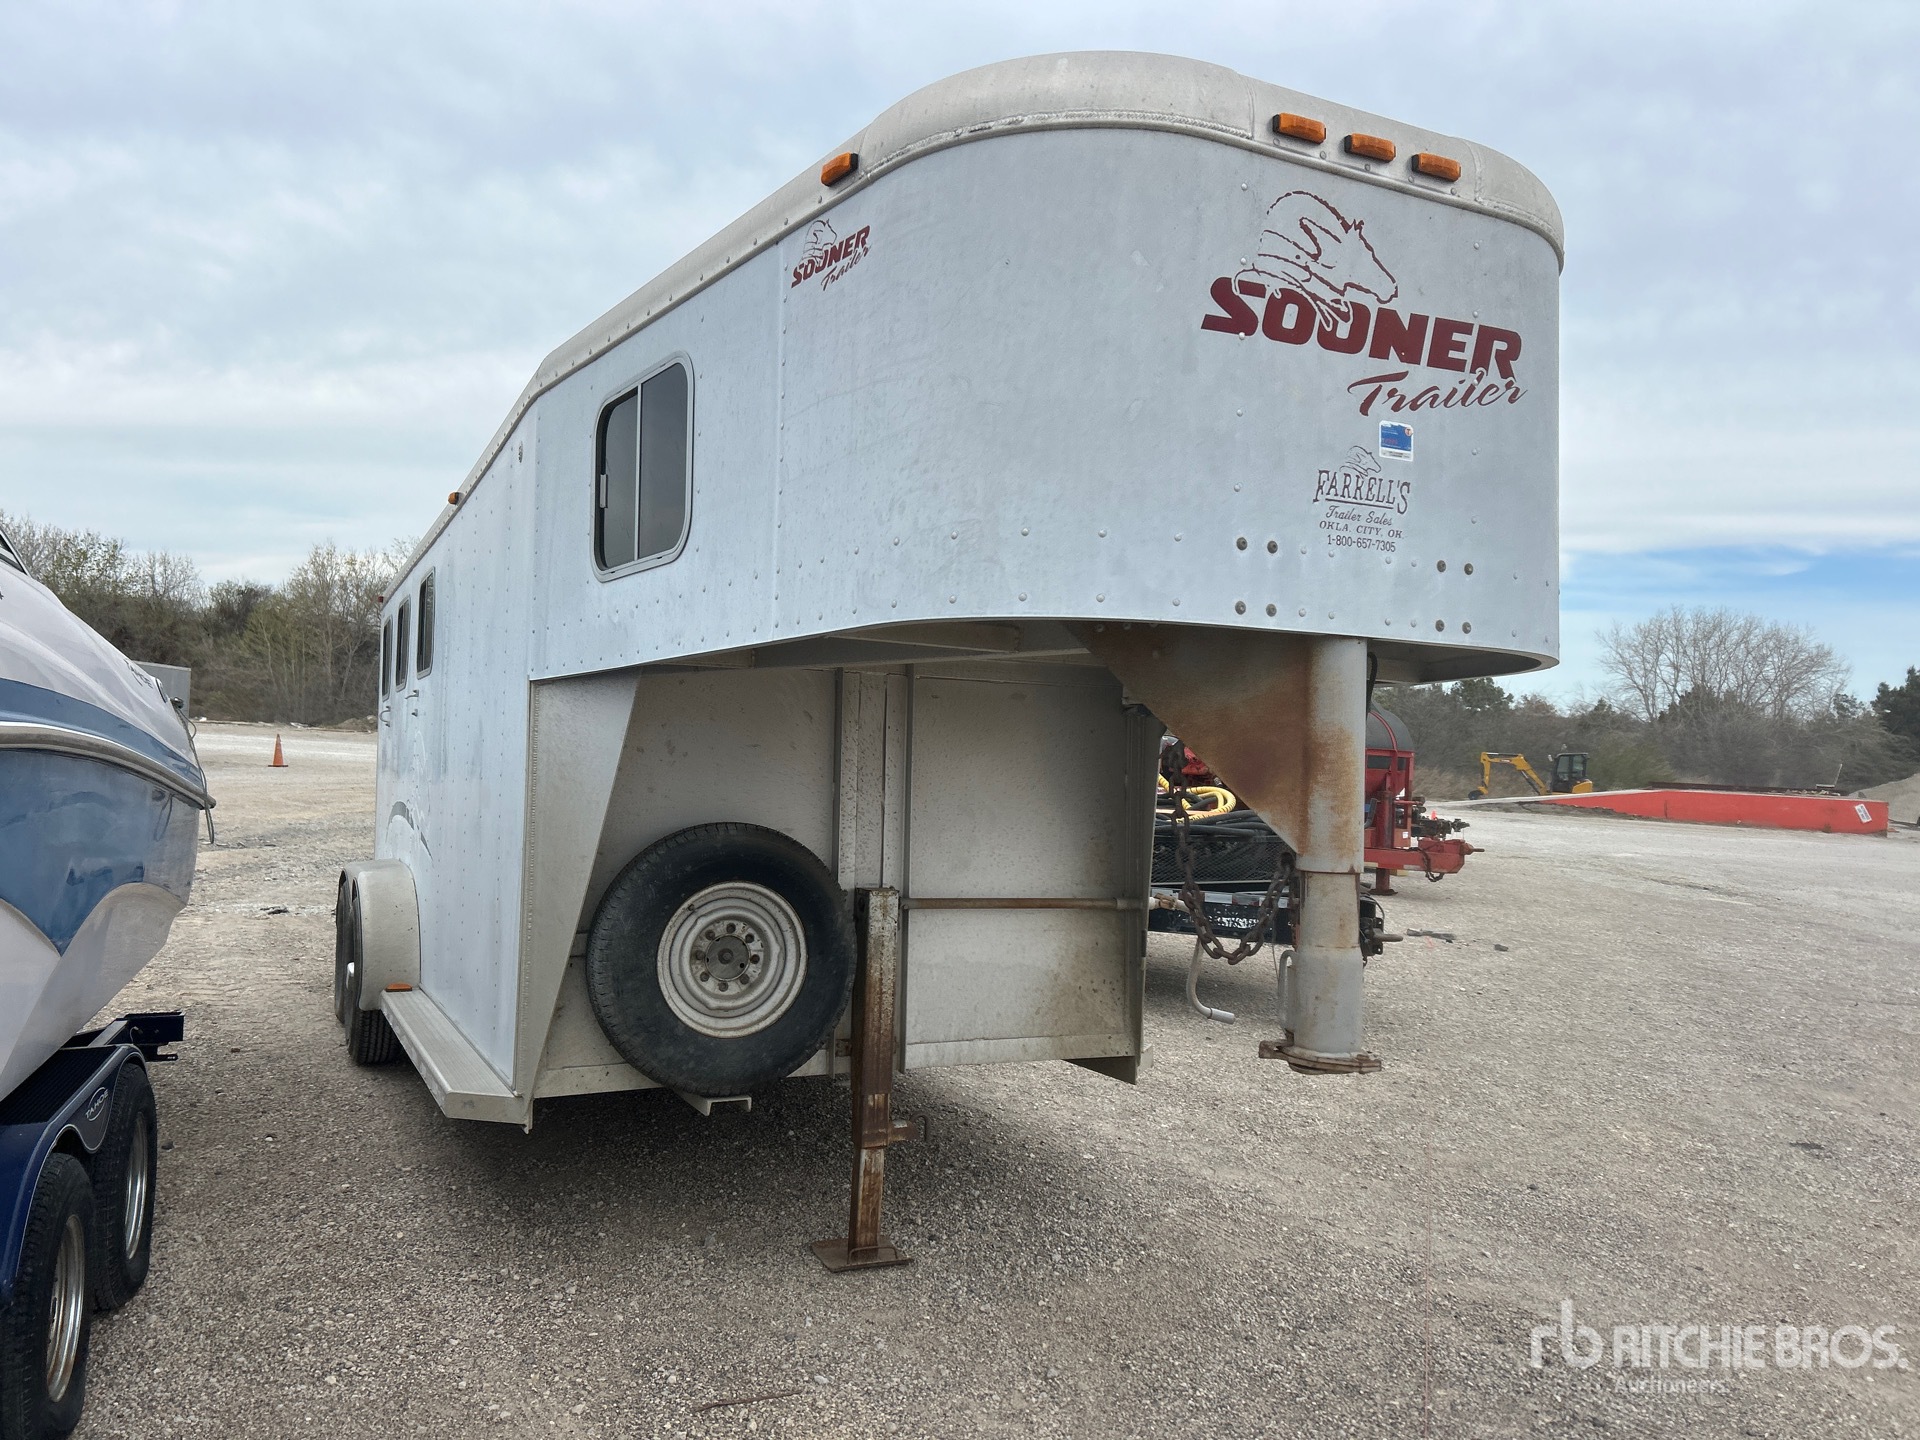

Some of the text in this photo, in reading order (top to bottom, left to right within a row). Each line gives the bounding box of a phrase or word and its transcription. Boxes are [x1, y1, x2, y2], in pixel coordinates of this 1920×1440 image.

[791, 225, 870, 289] SOONER
[1200, 276, 1522, 381] SOONER
[1346, 370, 1528, 417] Trailer
[1312, 469, 1411, 515] FARRELL'S
[1325, 505, 1361, 522] Trailer
[85, 1089, 109, 1119] TAHOE
